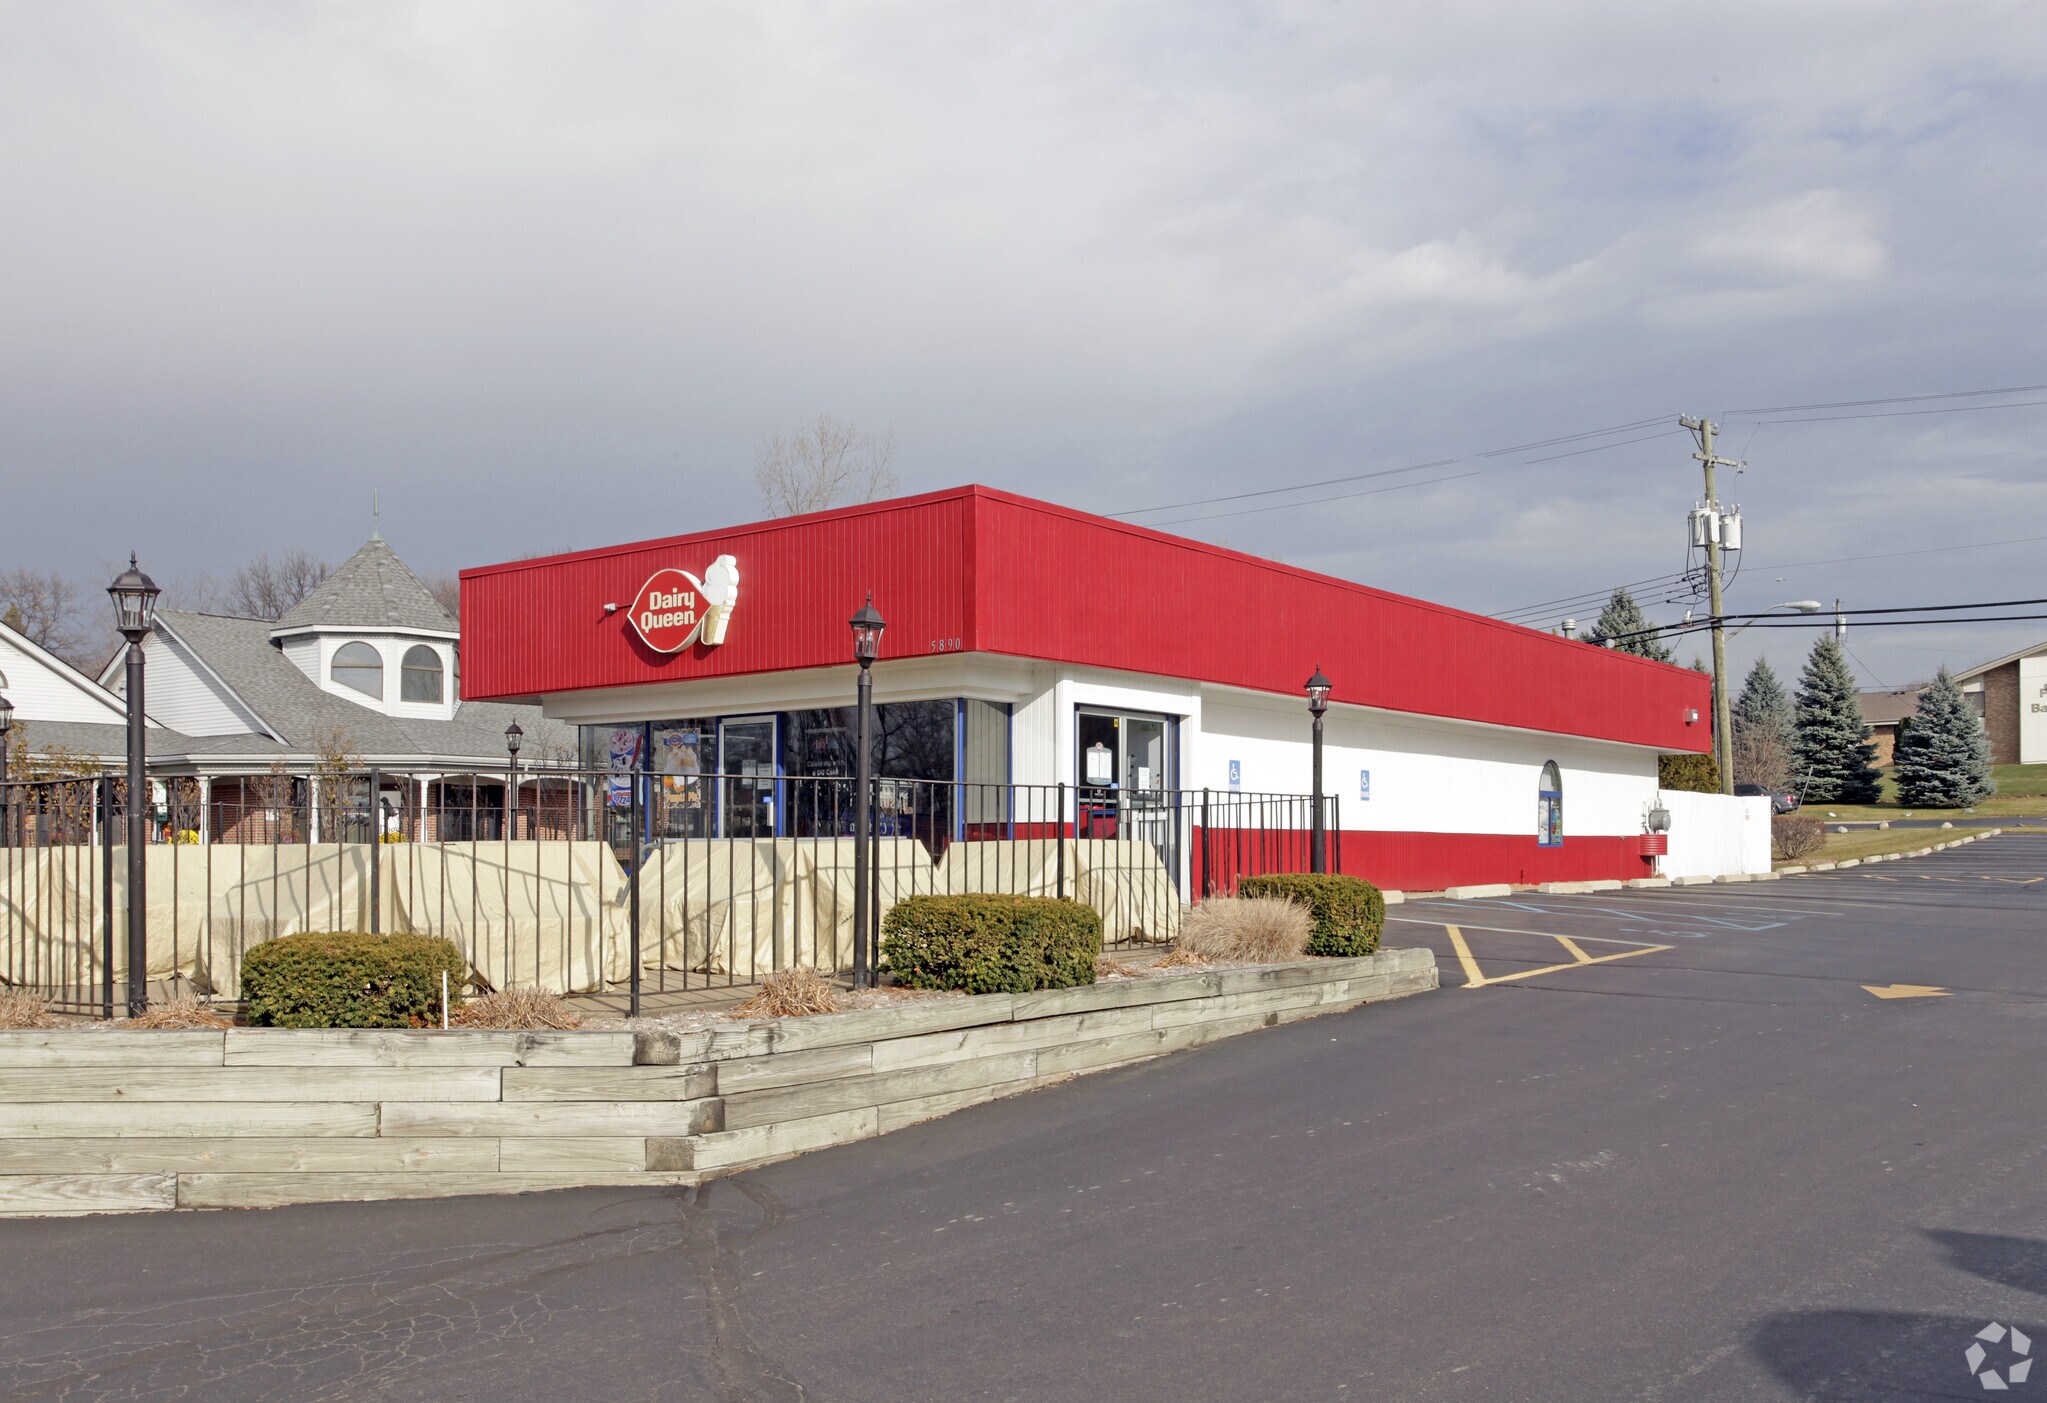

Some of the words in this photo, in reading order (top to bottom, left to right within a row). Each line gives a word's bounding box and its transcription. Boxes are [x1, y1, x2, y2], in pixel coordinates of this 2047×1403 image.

[649, 587, 695, 610] Dairy
[641, 609, 695, 634] Queen
[931, 637, 961, 653] 5890
